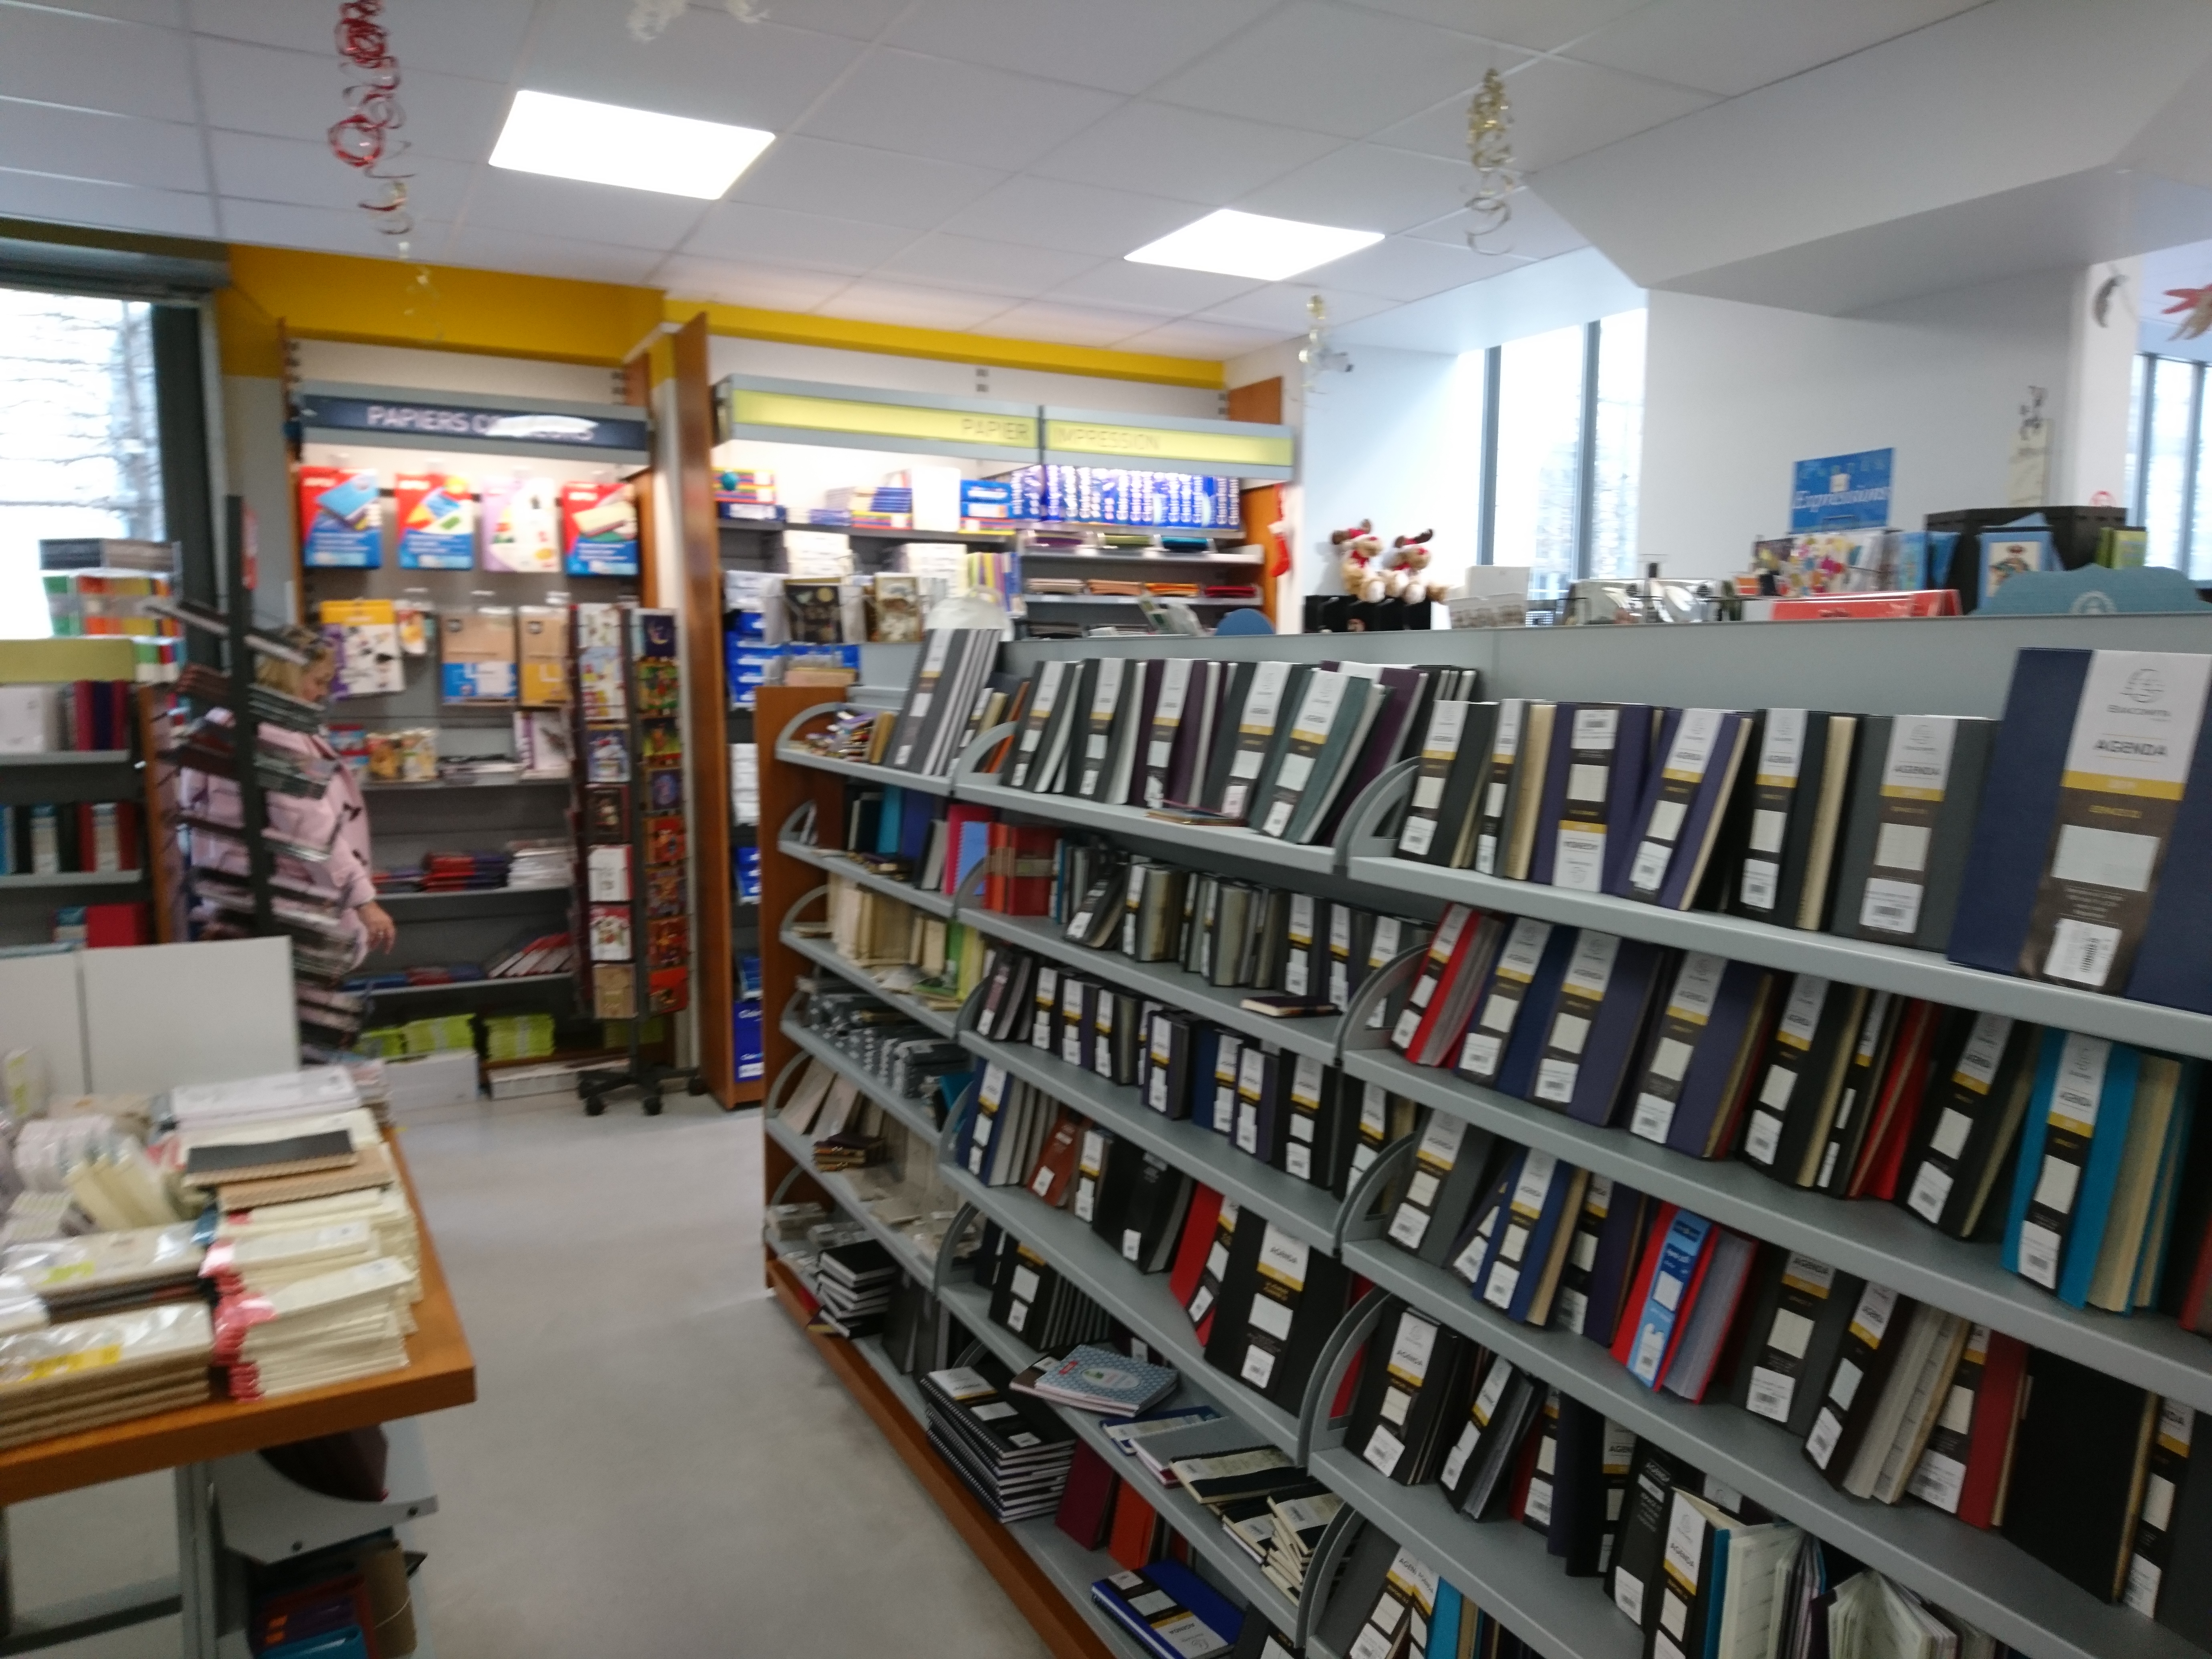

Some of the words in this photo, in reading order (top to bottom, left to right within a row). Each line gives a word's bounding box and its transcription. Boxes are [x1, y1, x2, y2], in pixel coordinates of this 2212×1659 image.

[367, 405, 470, 432] PAPIERS
[963, 418, 1030, 441] PAPIER
[1053, 426, 1160, 450] IMPRESSION
[2093, 739, 2168, 756] AGENDA
